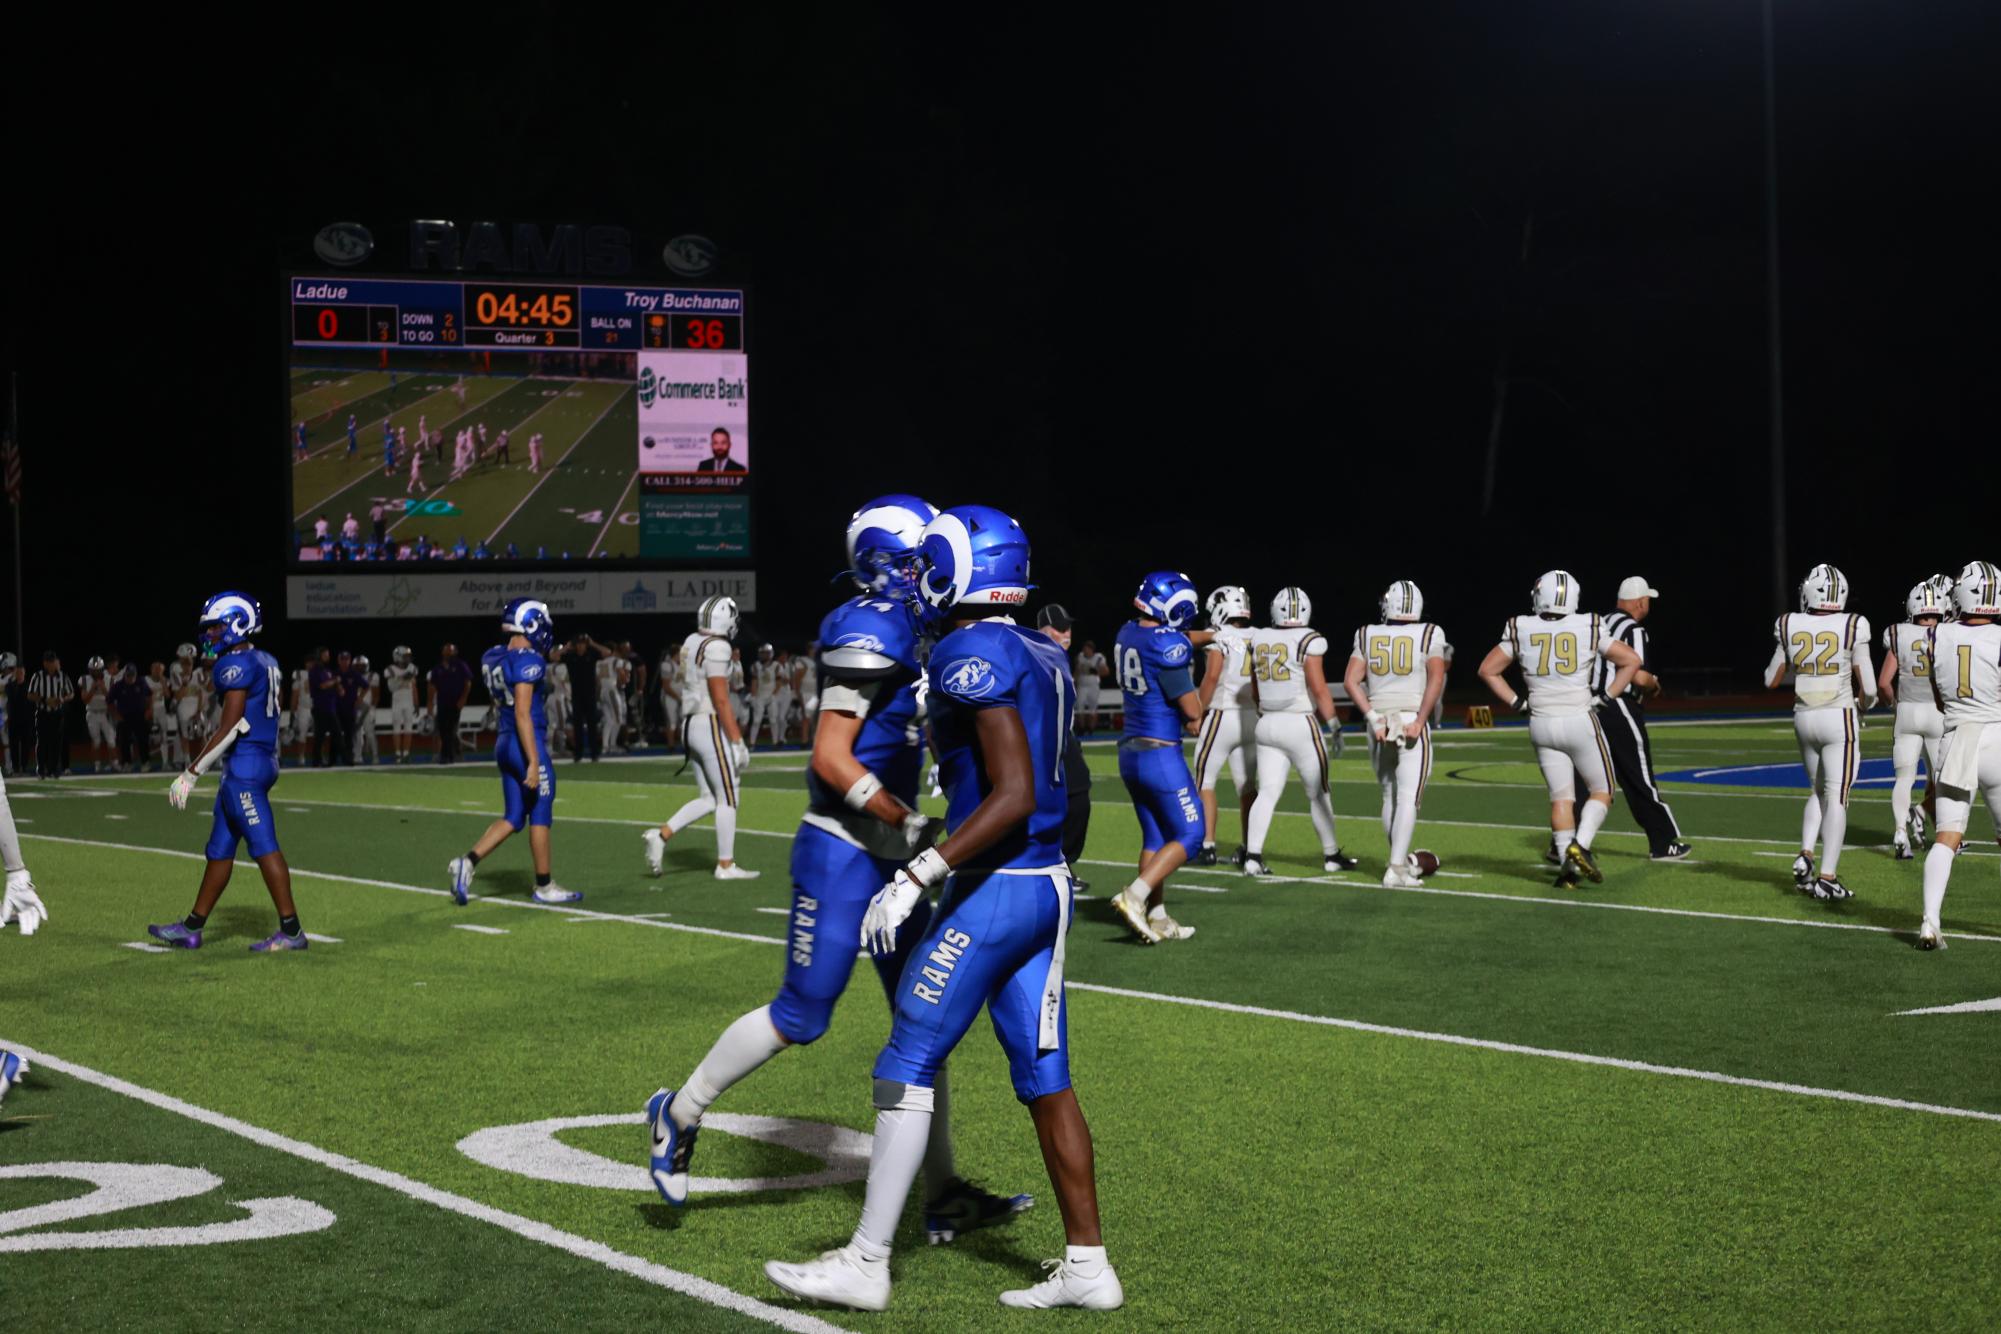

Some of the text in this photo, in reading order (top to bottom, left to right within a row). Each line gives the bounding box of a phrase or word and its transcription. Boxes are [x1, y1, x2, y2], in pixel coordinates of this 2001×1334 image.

[409, 219, 633, 273] RAMS
[296, 283, 348, 300] Ladue
[624, 292, 740, 311] Troy Buchanan
[402, 313, 454, 327] DOWN 2
[476, 291, 573, 327] 04:45
[590, 316, 632, 329] BALL ON
[318, 309, 338, 339] 0
[402, 329, 457, 342] TO GO 10
[687, 319, 725, 349] 36
[495, 331, 555, 346] Quarter 3
[658, 376, 746, 400] Commerce Bank
[645, 476, 670, 486] CALL
[459, 578, 587, 594] Above and Beyond
[667, 578, 748, 597] LADUE
[471, 598, 491, 611] for
[1369, 635, 1413, 676] 50
[1530, 631, 1578, 677] 79
[1791, 630, 1840, 676] 22
[1956, 644, 1974, 699] 1
[1474, 708, 1490, 727] 40
[239, 791, 261, 827] RAMS
[1176, 787, 1199, 824] RAMS
[792, 895, 818, 967] RAMS
[912, 927, 973, 1006] RAMS
